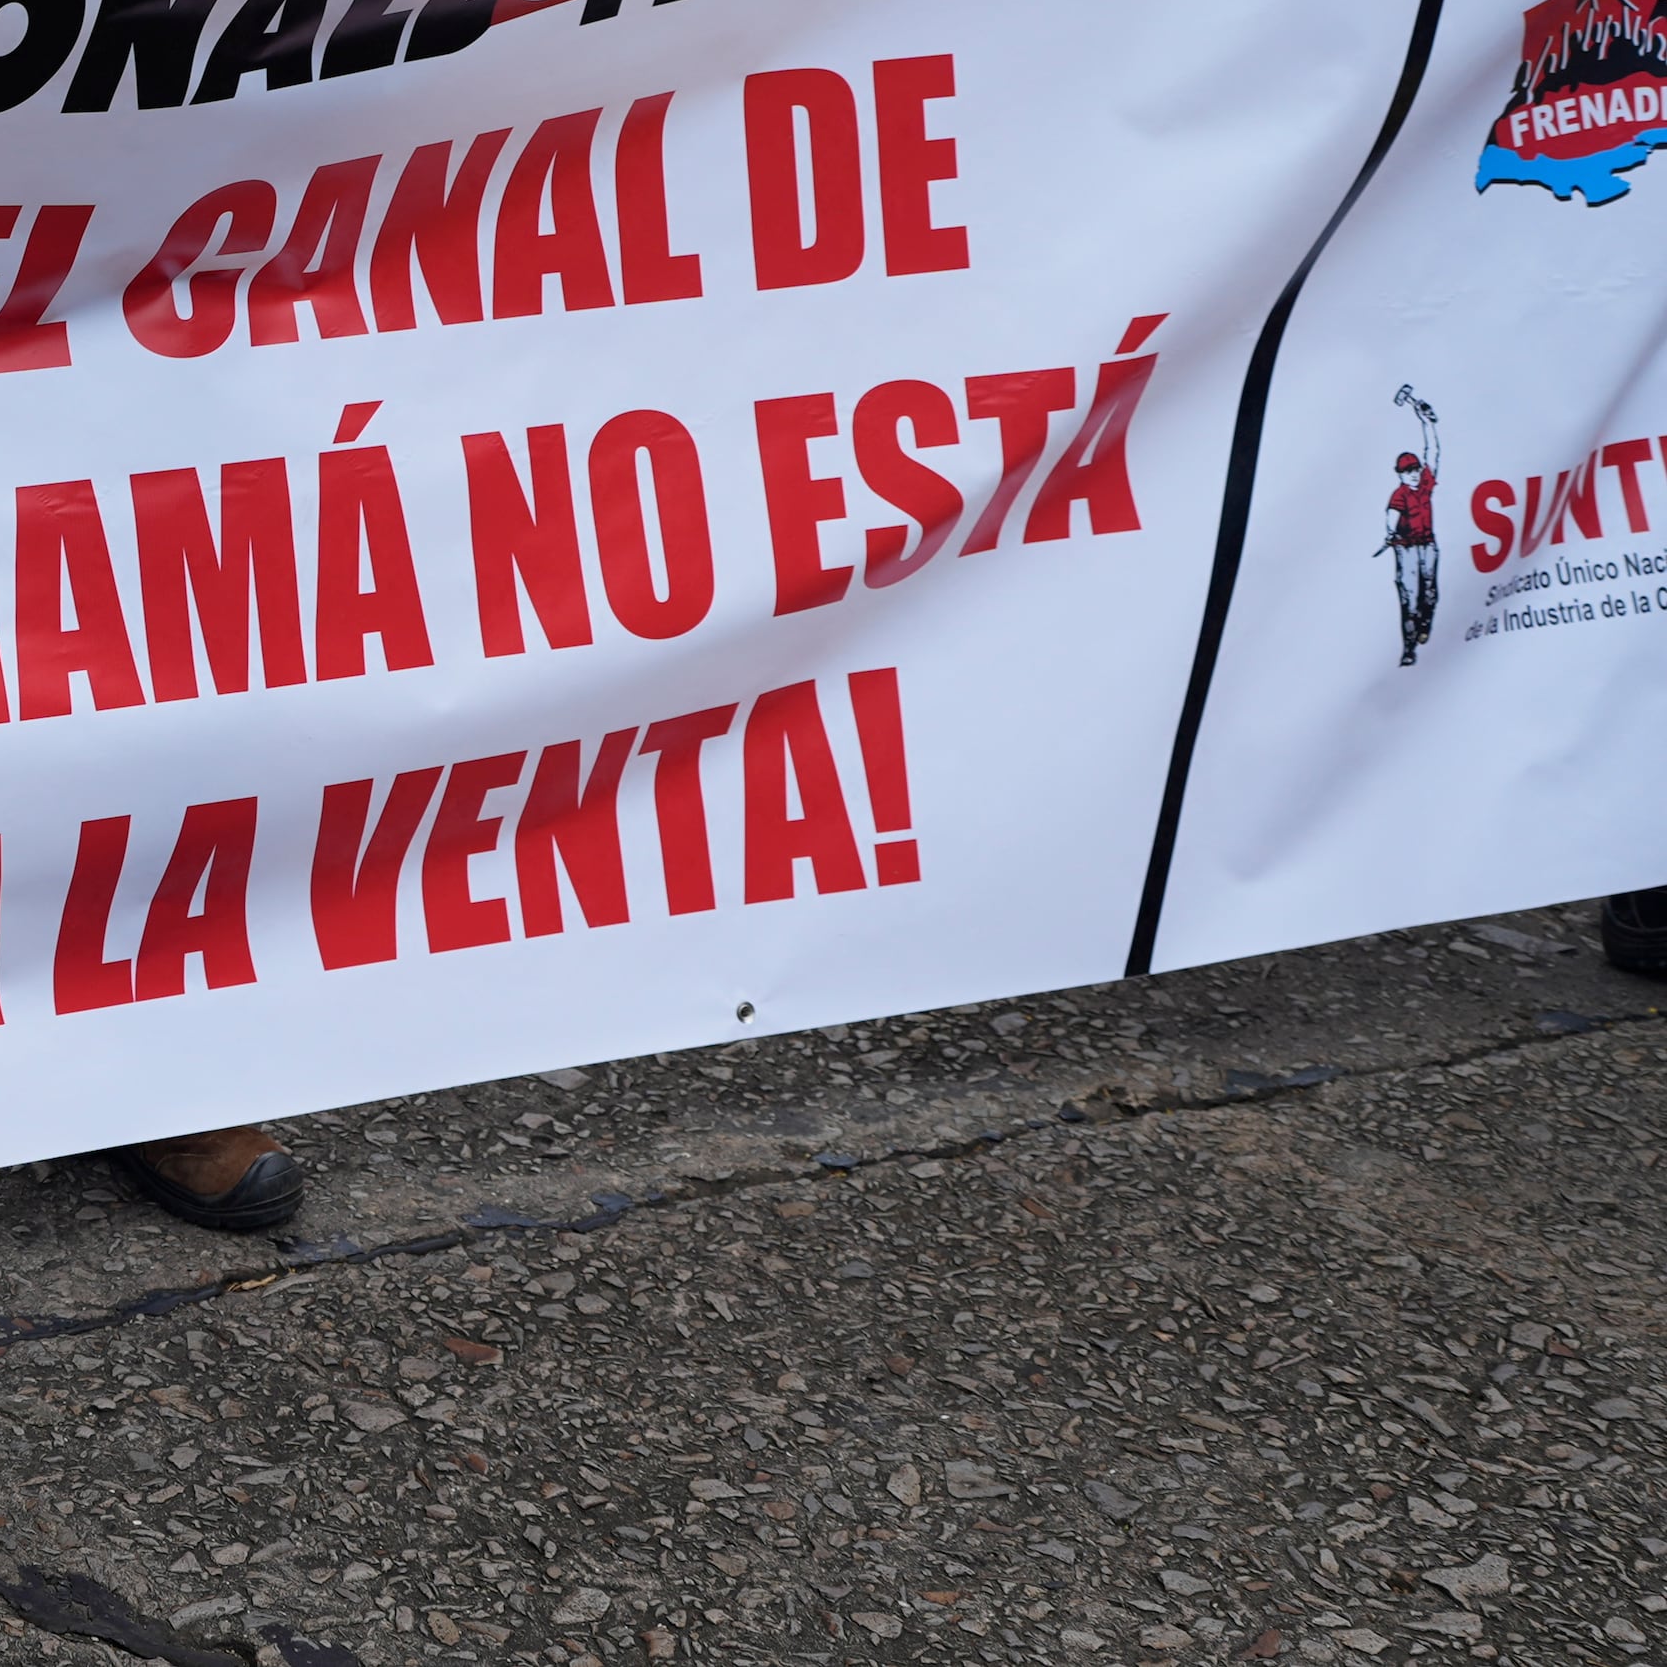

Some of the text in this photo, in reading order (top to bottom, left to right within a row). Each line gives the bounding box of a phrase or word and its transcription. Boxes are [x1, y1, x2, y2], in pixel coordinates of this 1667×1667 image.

[1510, 85, 1667, 147] FRENAD
[121, 90, 703, 360] CANAL
[742, 52, 971, 292] DE
[459, 408, 715, 660] NO
[753, 313, 1169, 617] ESTÁ
[1471, 435, 1667, 574] SUNT
[1503, 598, 1595, 632] Industria
[1600, 594, 1627, 622] de
[1631, 591, 1652, 615] la
[1555, 556, 1619, 586] Único
[52, 795, 259, 1016] LA
[308, 665, 923, 972] VENTA!
